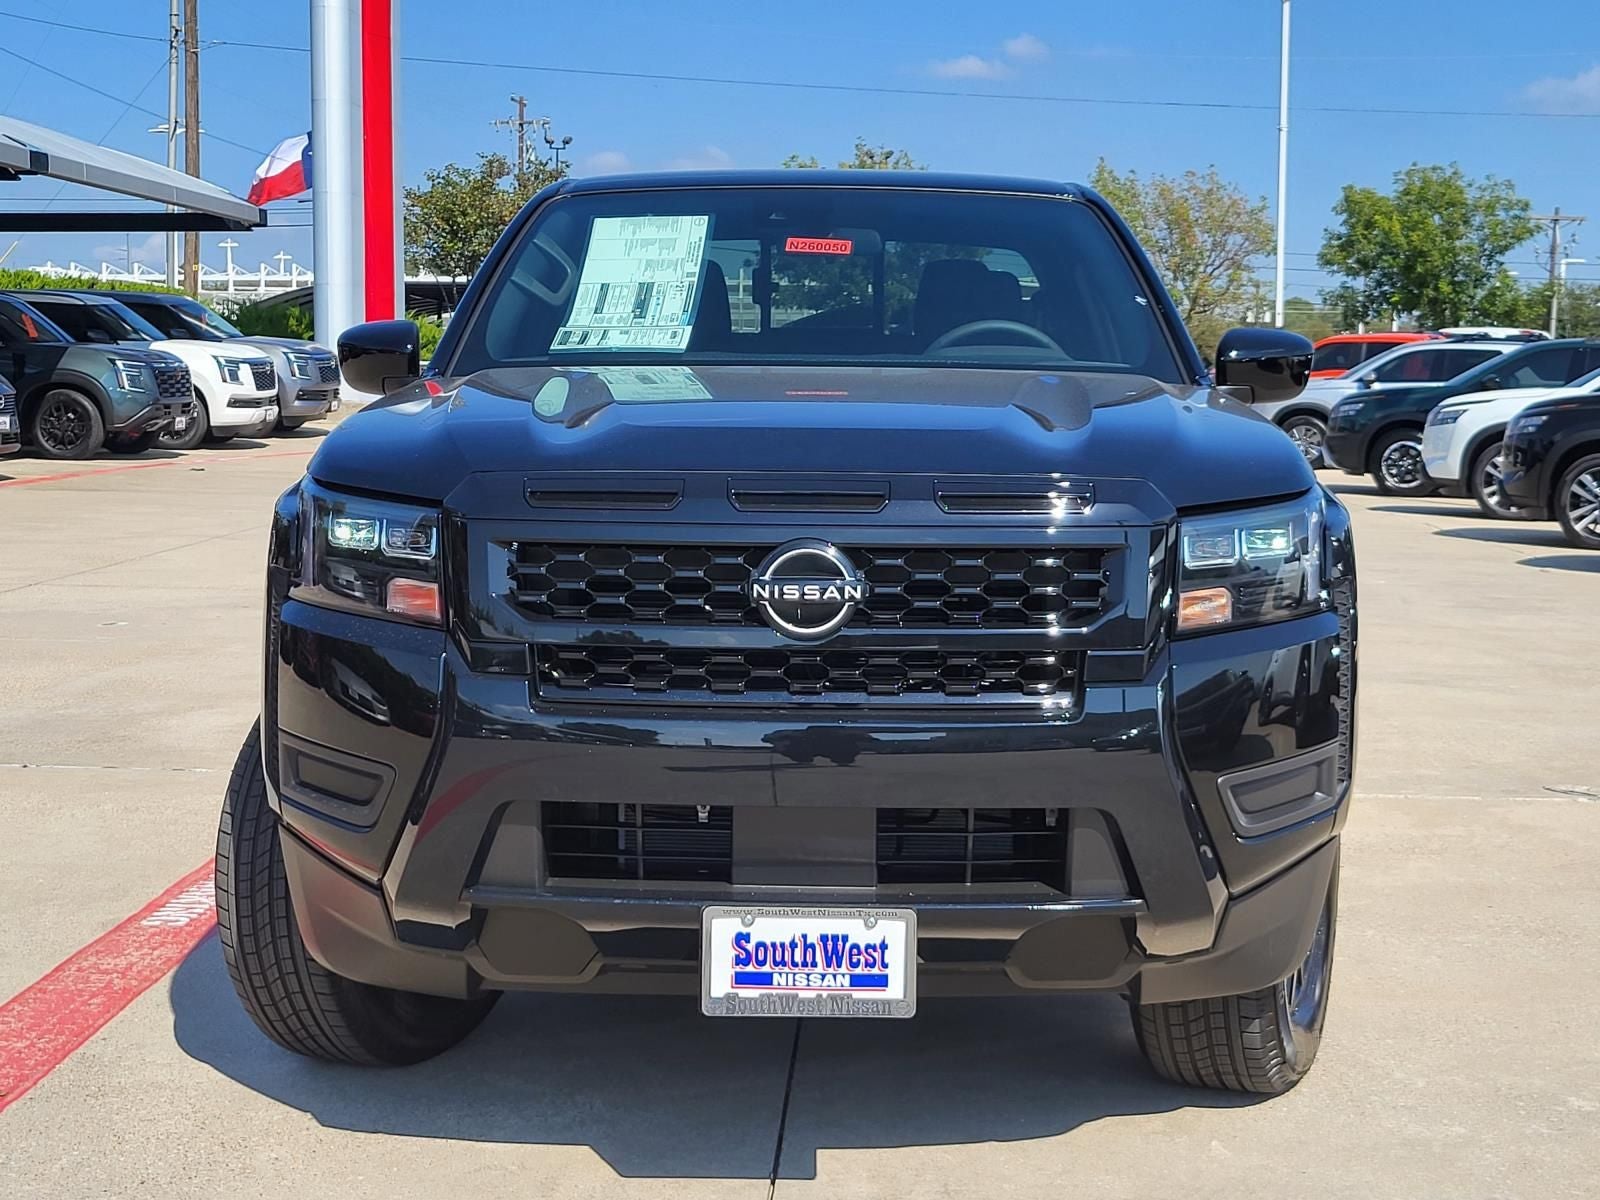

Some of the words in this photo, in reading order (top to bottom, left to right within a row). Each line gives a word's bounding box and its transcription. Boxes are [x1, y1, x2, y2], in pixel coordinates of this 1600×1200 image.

[789, 241, 848, 253] N260050
[753, 583, 862, 600] NISSAN
[772, 972, 851, 988] NISSAN
[830, 994, 892, 1017] Nissan
